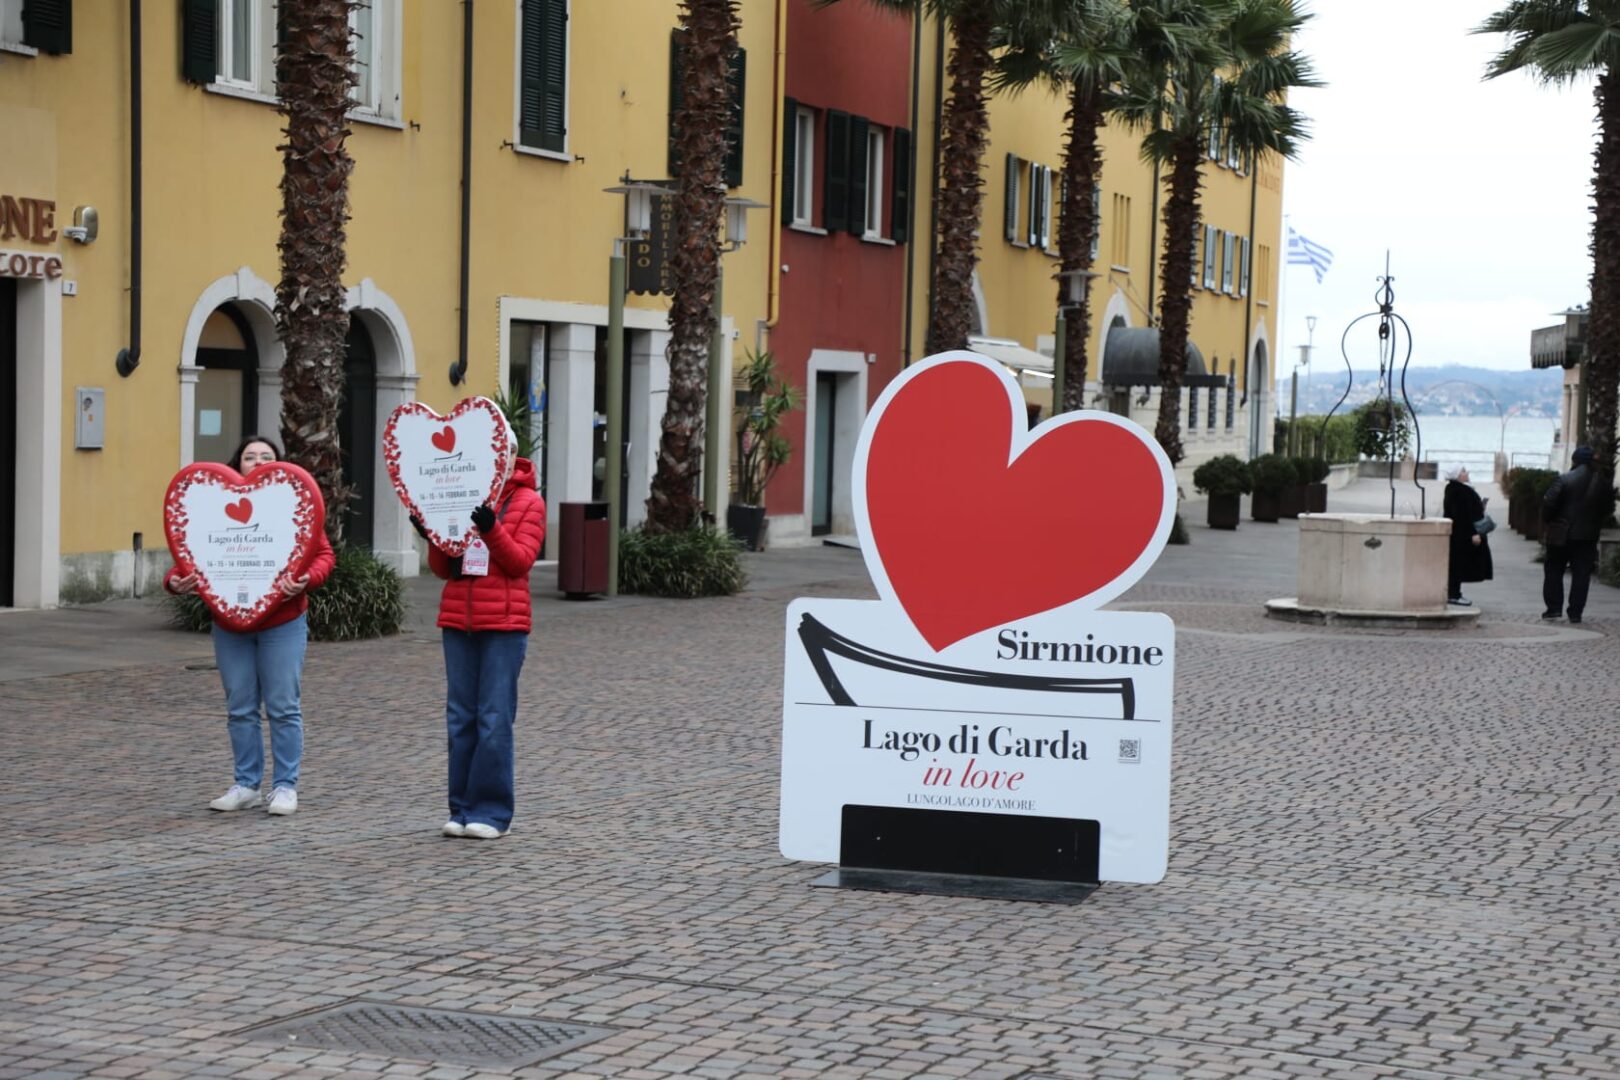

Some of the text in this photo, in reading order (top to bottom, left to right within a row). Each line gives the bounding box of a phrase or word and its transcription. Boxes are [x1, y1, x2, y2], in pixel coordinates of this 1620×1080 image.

[0, 194, 57, 245] NE
[419, 462, 476, 478] Lago di Garda
[208, 534, 273, 546] Lago di Garda
[997, 628, 1163, 666] Sirmione
[861, 719, 1089, 761] Lago di Garda
[922, 758, 1025, 790] in love
[907, 793, 1036, 811] LUNGOLAGO D'AMORE
